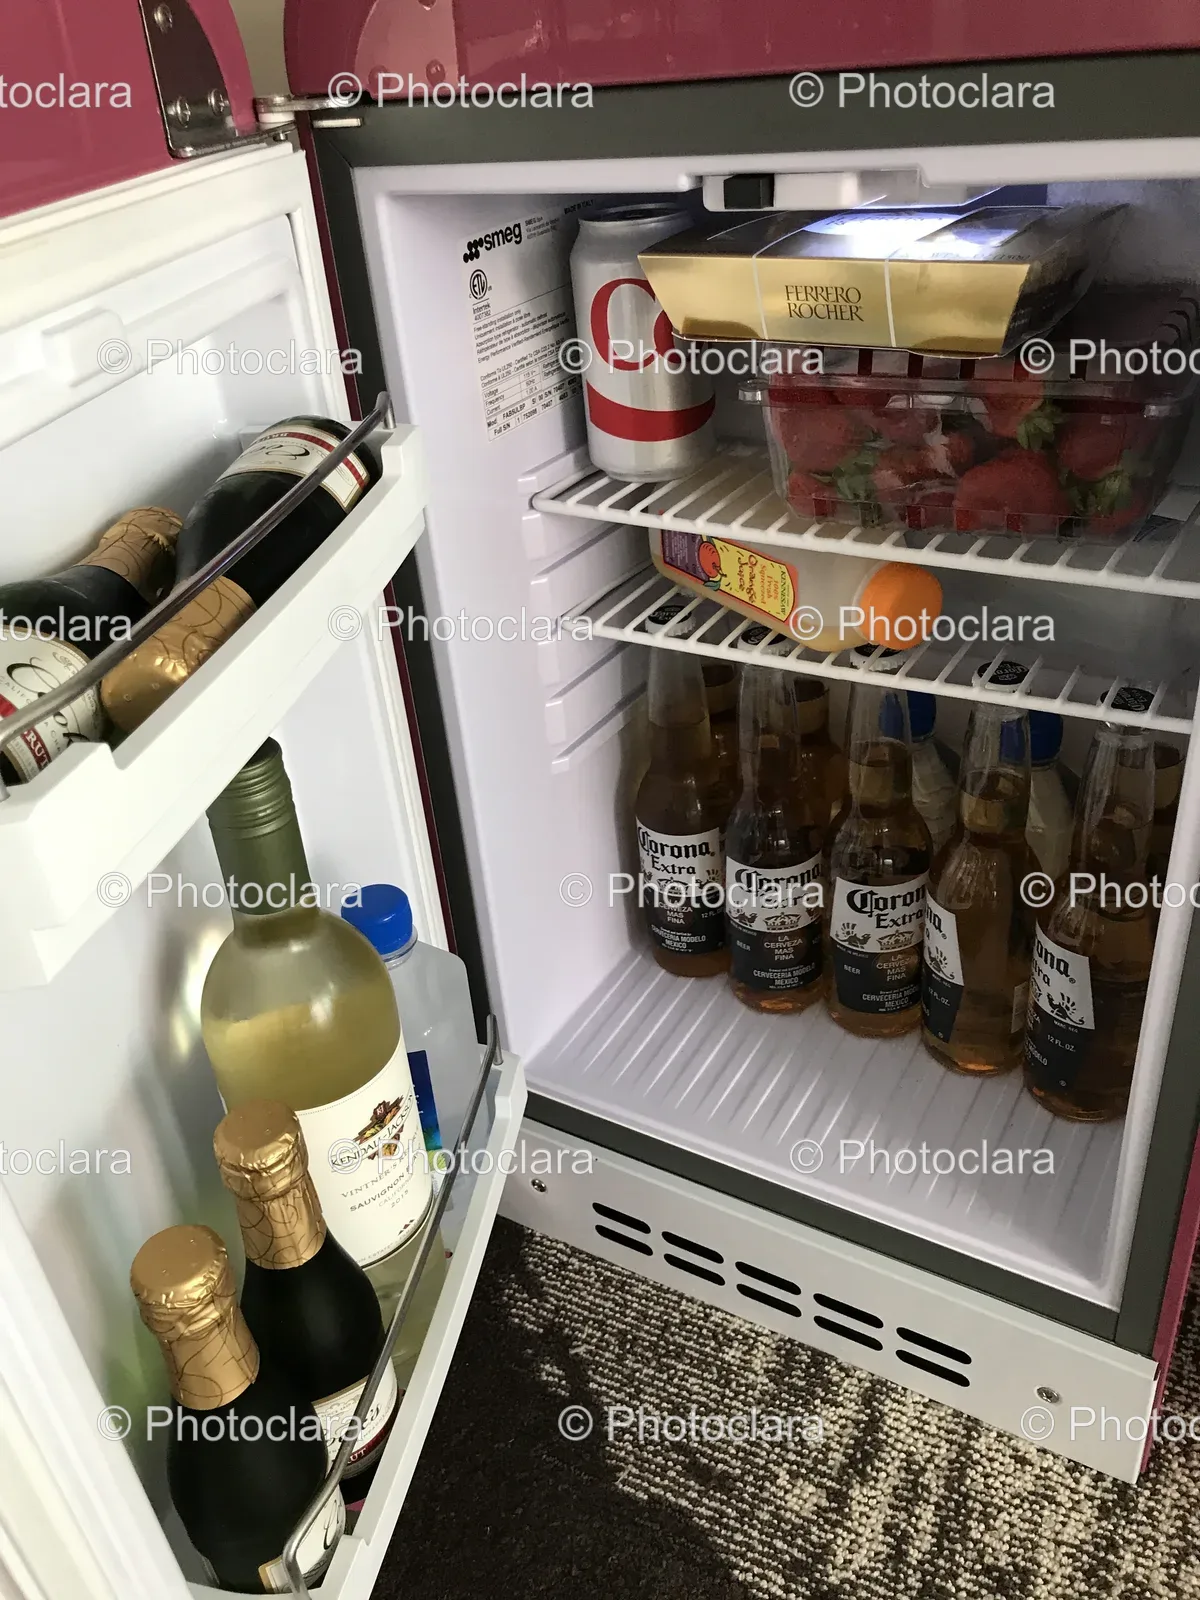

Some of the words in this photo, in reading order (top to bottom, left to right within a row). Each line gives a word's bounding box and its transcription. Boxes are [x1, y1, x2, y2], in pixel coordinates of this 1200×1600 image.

[484, 223, 522, 251] smeg
[785, 285, 862, 304] FERRERO
[473, 303, 491, 315] Intertek
[485, 394, 504, 408] Frequency
[486, 404, 500, 415] Current
[493, 426, 502, 435] Full
[747, 554, 758, 604] Orange
[638, 826, 711, 859] Corona
[651, 855, 697, 875] Extra
[846, 884, 925, 918] Coron
[874, 908, 924, 929] Extra
[736, 940, 751, 952] BEER
[764, 938, 804, 949] CERVEZA
[753, 968, 792, 980] CERVECERIA
[843, 964, 861, 975] BEER
[887, 966, 906, 975] MAS
[774, 977, 799, 986] MEXICO
[886, 973, 907, 982] FINA
[862, 990, 902, 1001] CERVECERIA
[1047, 1034, 1055, 1043] 12
[1065, 1042, 1076, 1053] OZ.
[341, 1163, 397, 1198] VINTNER'S
[350, 1173, 405, 1212] SAUVIGNON
[390, 1189, 409, 1208] 2015
